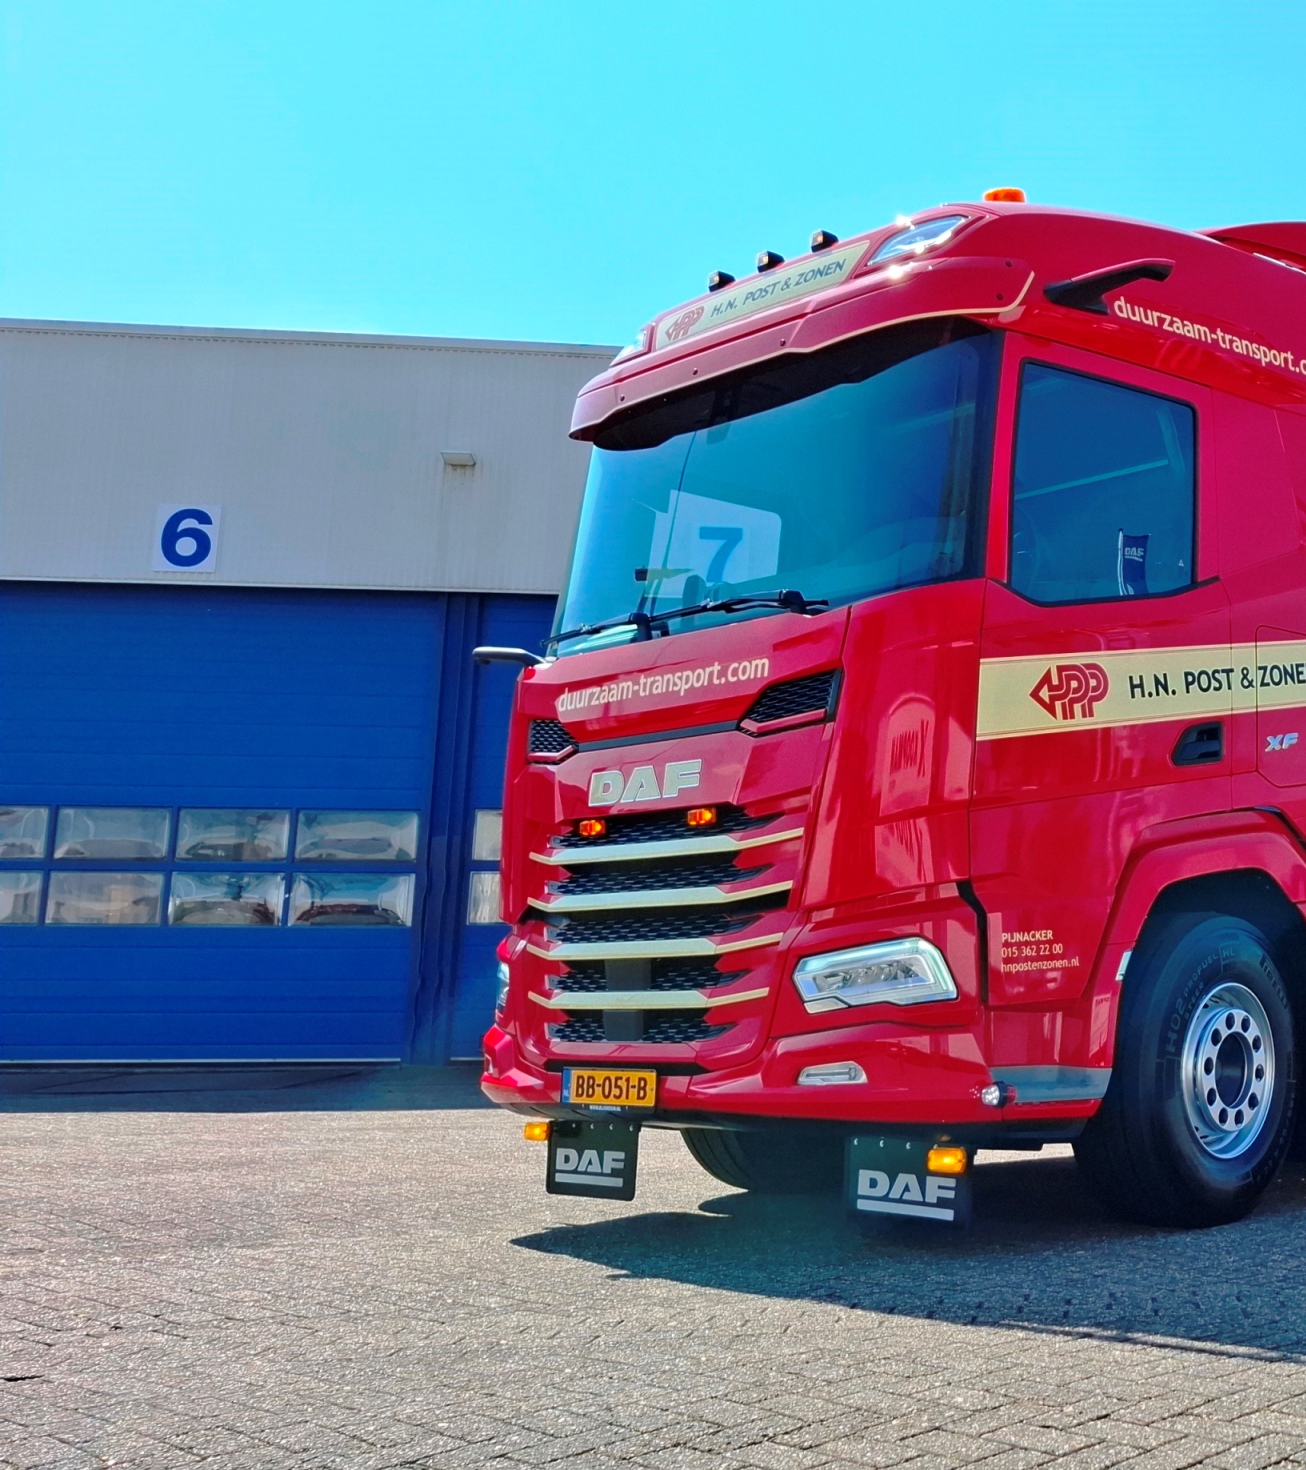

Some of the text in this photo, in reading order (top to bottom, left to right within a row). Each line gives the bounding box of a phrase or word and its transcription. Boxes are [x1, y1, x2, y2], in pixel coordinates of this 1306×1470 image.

[710, 258, 847, 318] H.N. POST & ZONEN
[161, 508, 213, 567] 6
[1124, 547, 1144, 557] DAF
[699, 526, 743, 582] 7
[558, 657, 769, 712] duurzaam-transport.com
[1128, 673, 1177, 699] H.N.
[1183, 668, 1235, 694] POST
[1240, 666, 1255, 690] &
[1264, 732, 1299, 752] XF
[588, 759, 702, 807] DAF
[1001, 943, 1063, 958] 015 362 22 00
[1002, 930, 1053, 943] PIJNACKER
[1001, 956, 1080, 974] hnpostenzonen.nl
[575, 1074, 649, 1101] BB-051-B
[555, 1147, 626, 1174] DAF
[857, 1169, 957, 1203] DAF
